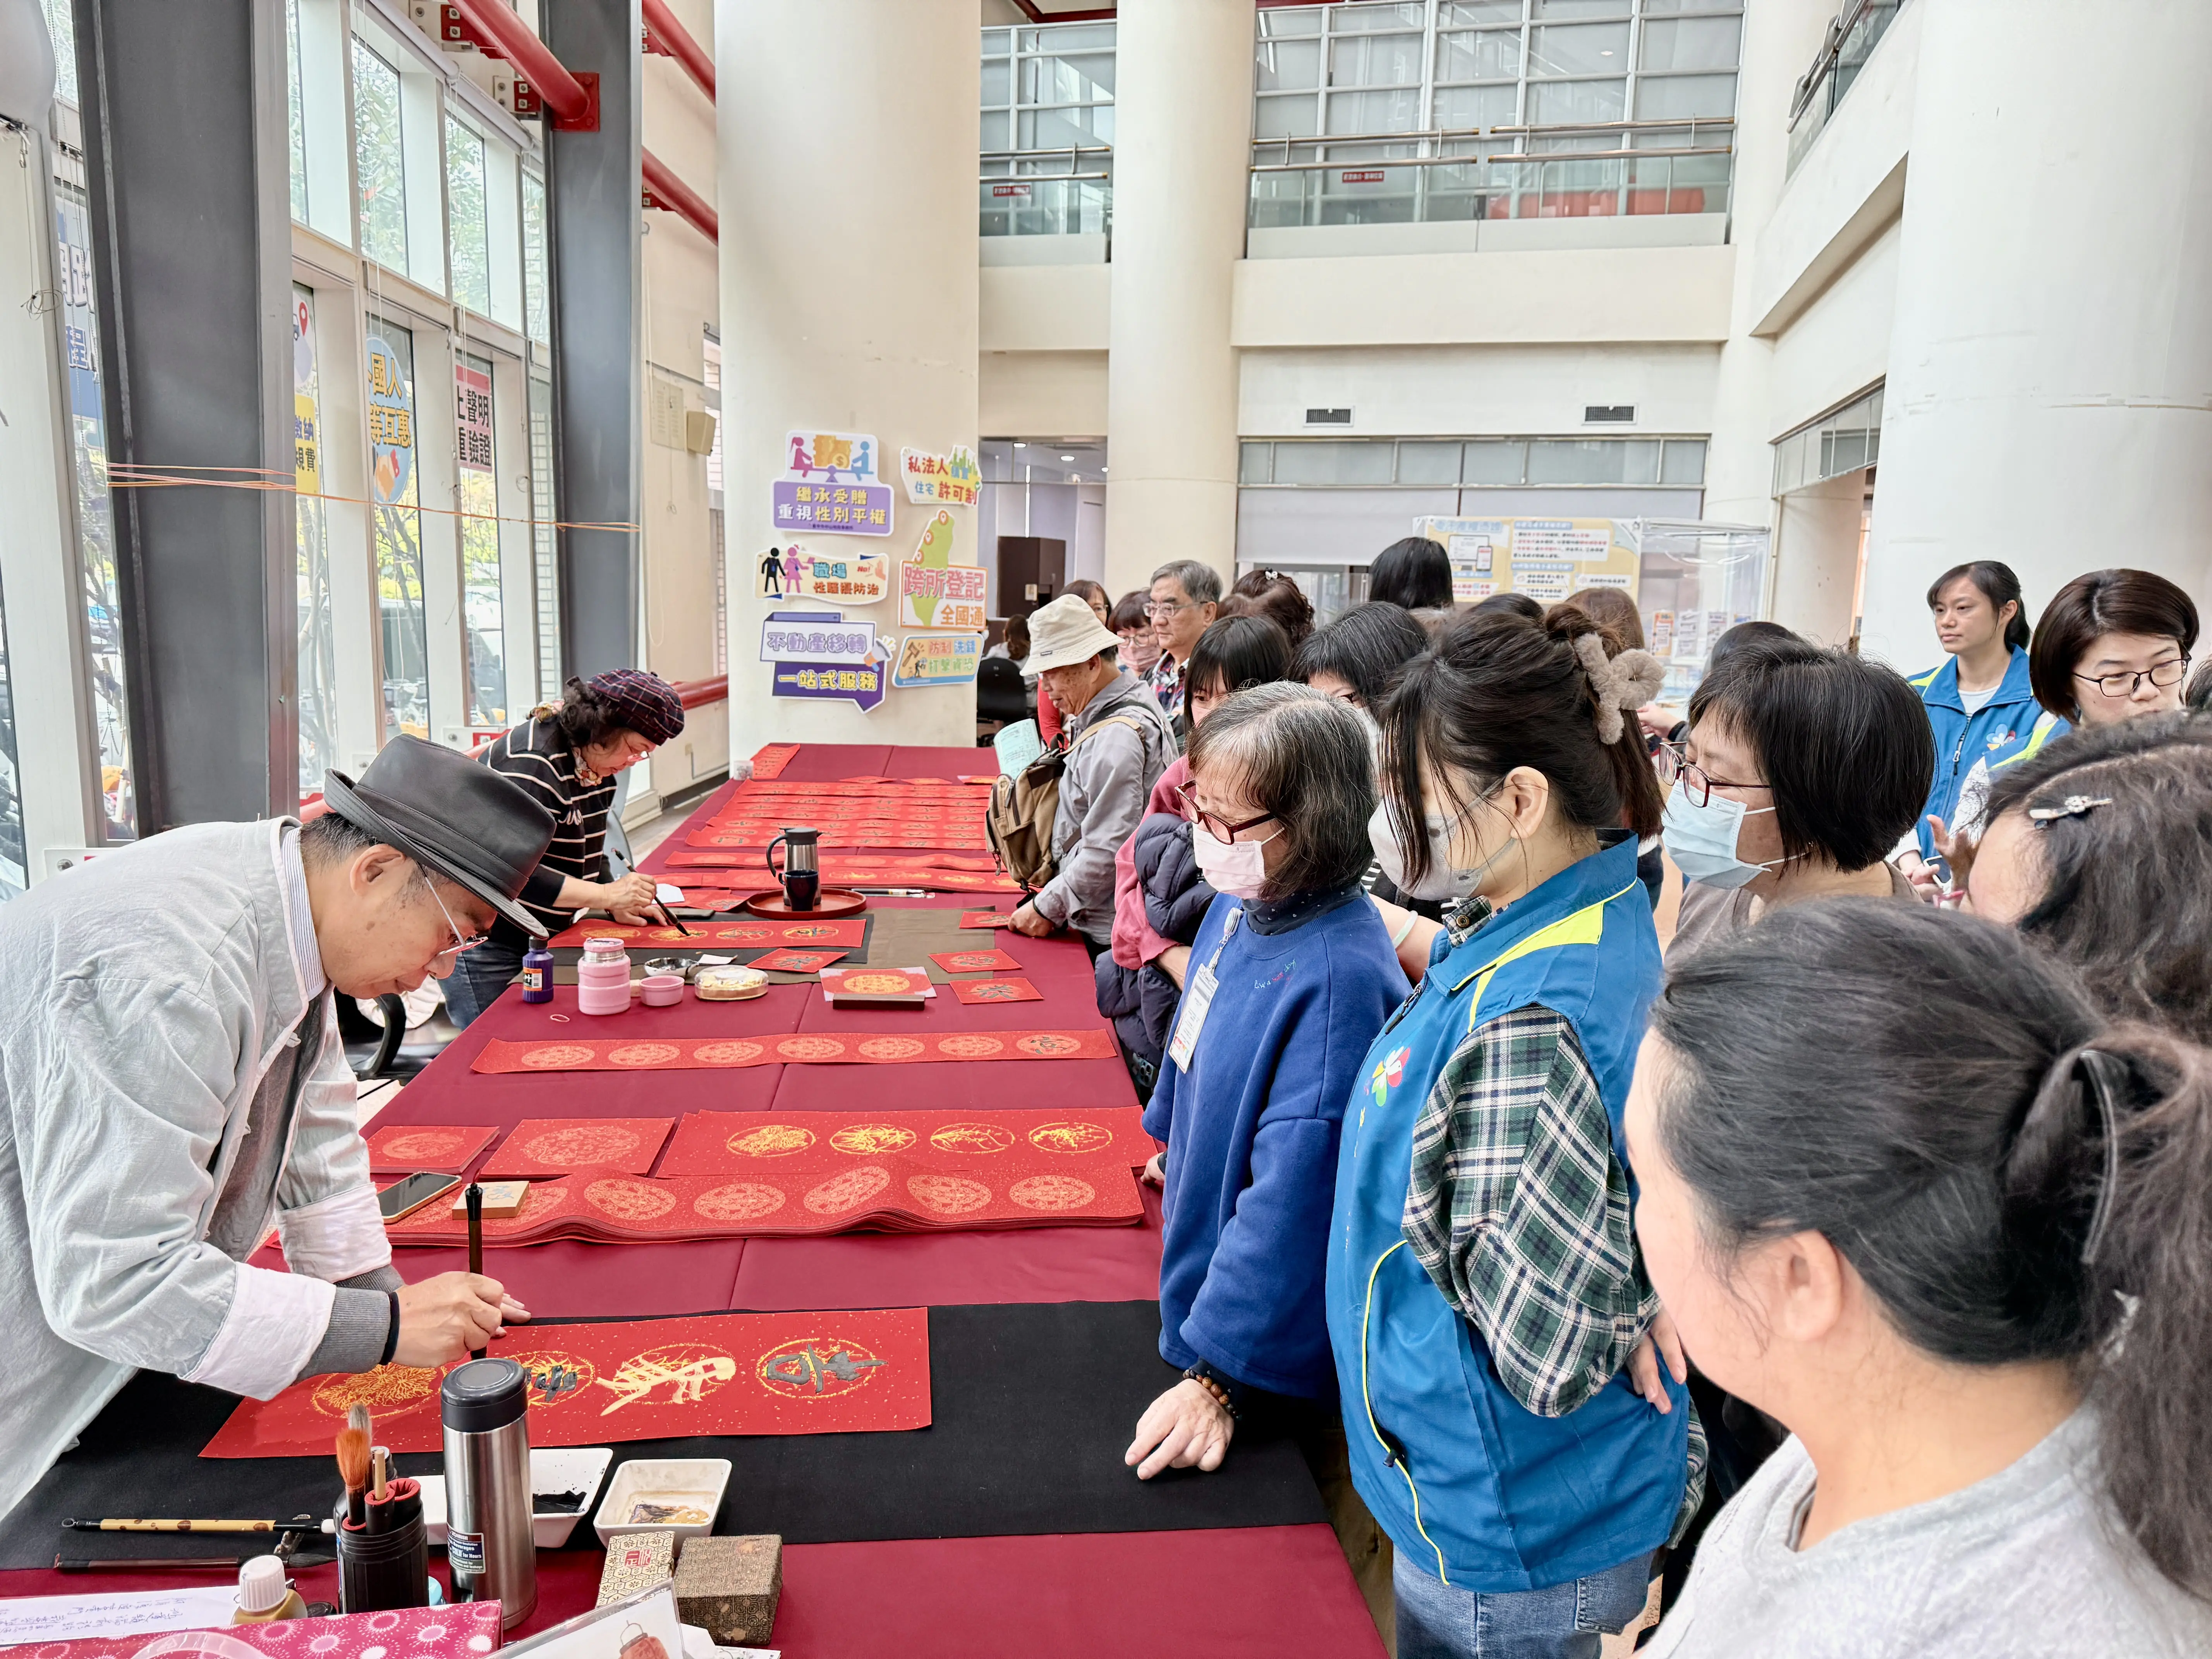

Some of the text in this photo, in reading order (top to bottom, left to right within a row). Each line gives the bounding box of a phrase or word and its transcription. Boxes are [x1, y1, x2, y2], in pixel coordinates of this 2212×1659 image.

[368, 352, 402, 400] 國人
[908, 455, 948, 475] 私法人
[796, 486, 867, 505] 繼承受贈
[915, 481, 977, 505] 住宅 許可制
[778, 503, 886, 525] 重視性別平權
[813, 562, 847, 579] 職場
[813, 581, 879, 595] 性騷擾防治
[904, 566, 985, 602] 跨所登記
[940, 604, 983, 626] 全國通
[767, 632, 867, 654] 不動產移轉
[778, 670, 878, 691] 一站式服務
